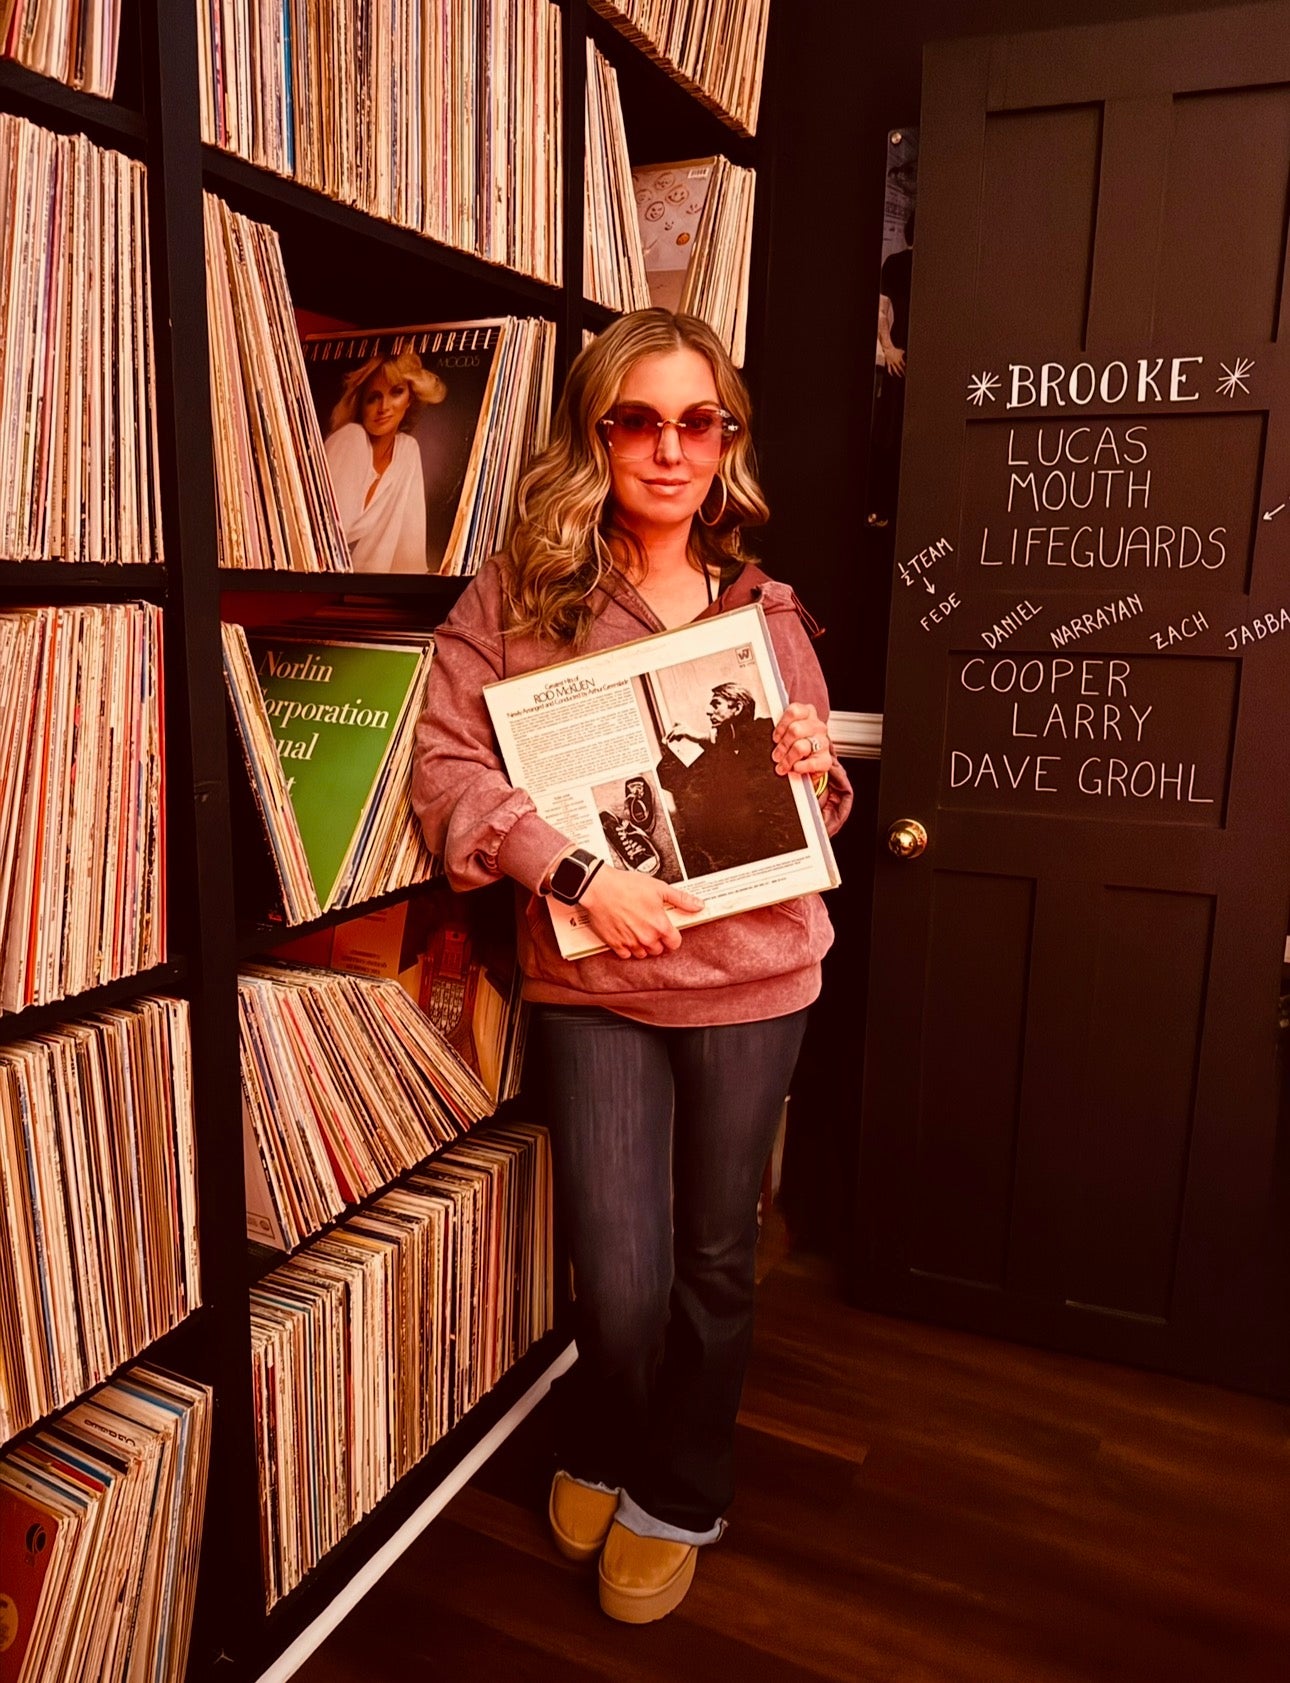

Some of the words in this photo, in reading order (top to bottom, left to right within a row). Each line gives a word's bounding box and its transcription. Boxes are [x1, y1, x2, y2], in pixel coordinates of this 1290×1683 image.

[436, 355, 480, 369] MOODS
[1006, 356, 1204, 410] BROOKE
[1008, 426, 1148, 466] LUCAS
[1007, 470, 1151, 513] MOUTH
[907, 537, 954, 574] TEAM
[980, 525, 1227, 570] LIFEGUARDS
[920, 592, 961, 632] FEDE
[981, 600, 1043, 649] DANIEL
[1050, 593, 1144, 649] NARRAYAN
[1149, 611, 1209, 650] ZACH
[1224, 608, 1290, 650] JABBA
[258, 651, 333, 683] Norlin
[961, 658, 1131, 698] COOPER
[262, 688, 390, 729] orporation
[533, 690, 555, 704] ROD
[556, 677, 596, 699] McKUEN
[1012, 702, 1153, 742] LARRY
[950, 751, 1061, 792] DAVE
[1078, 757, 1214, 803] GROHL
